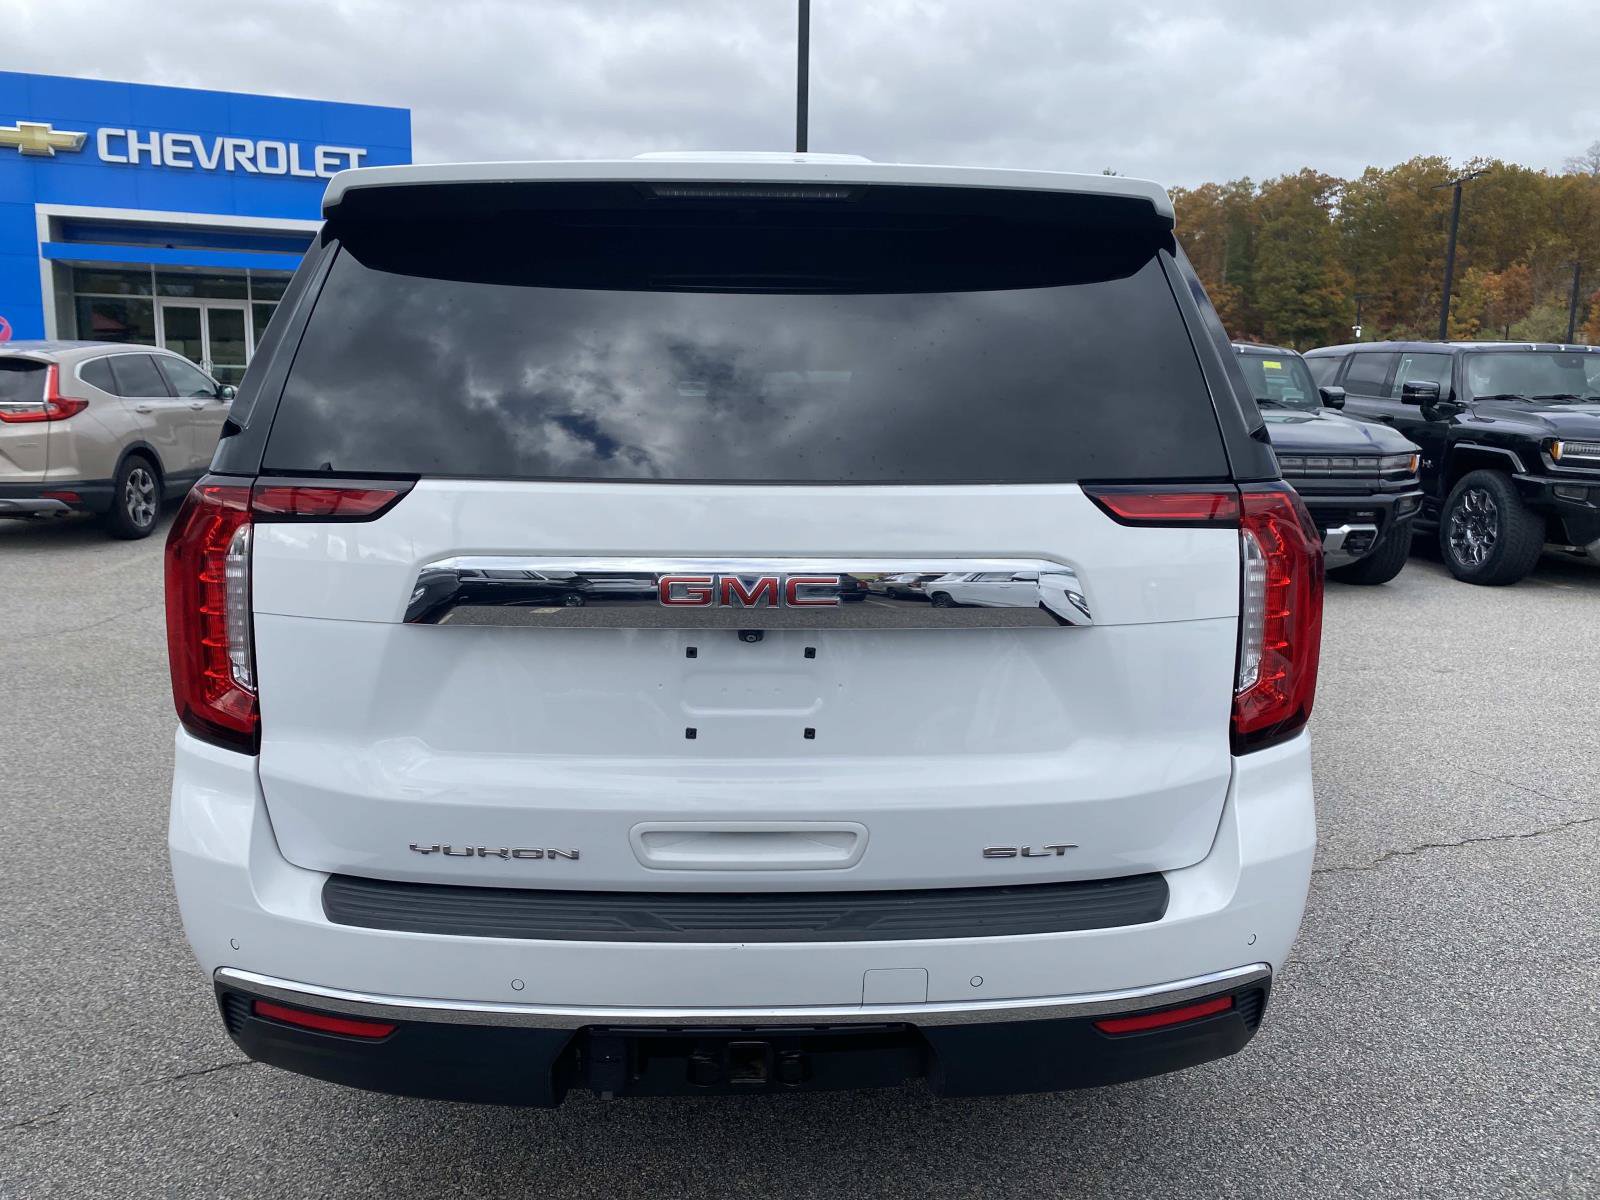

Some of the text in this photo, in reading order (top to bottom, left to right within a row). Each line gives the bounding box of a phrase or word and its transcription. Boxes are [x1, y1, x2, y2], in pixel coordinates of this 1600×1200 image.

[96, 127, 368, 178] CHEVROLET
[658, 575, 841, 608] GMC
[409, 844, 580, 861] YUKON
[982, 843, 1079, 858] SLT
